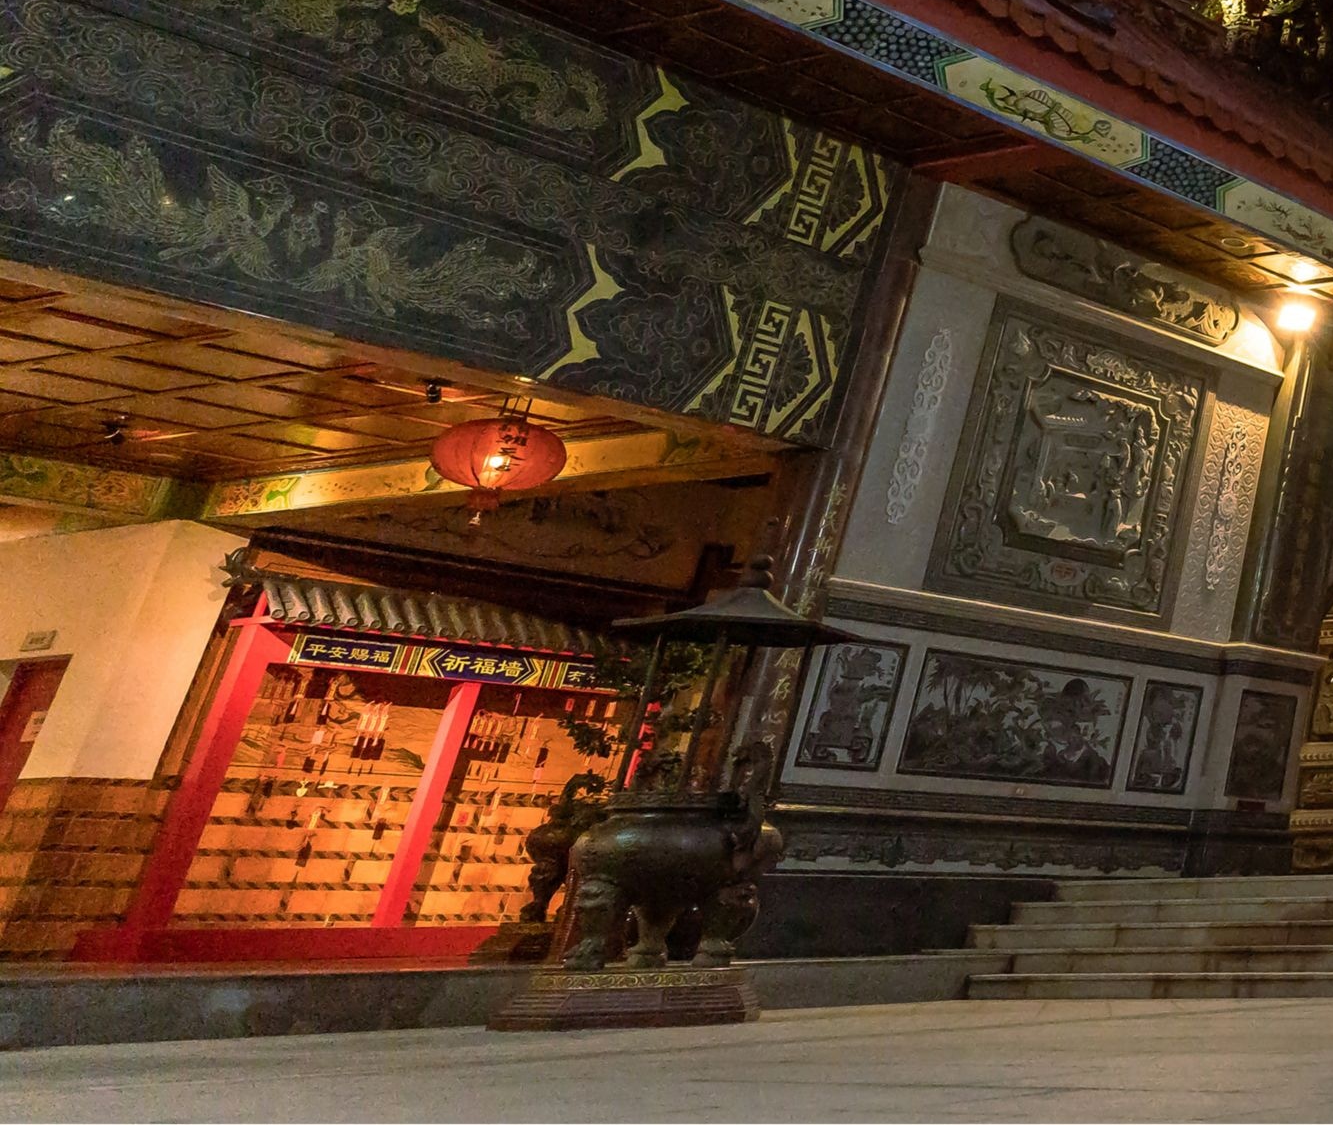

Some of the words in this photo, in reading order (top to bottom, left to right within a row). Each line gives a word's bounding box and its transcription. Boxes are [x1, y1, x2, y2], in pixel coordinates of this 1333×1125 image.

[305, 643, 392, 664] 平安赐福
[441, 654, 524, 677] 祈福墙
